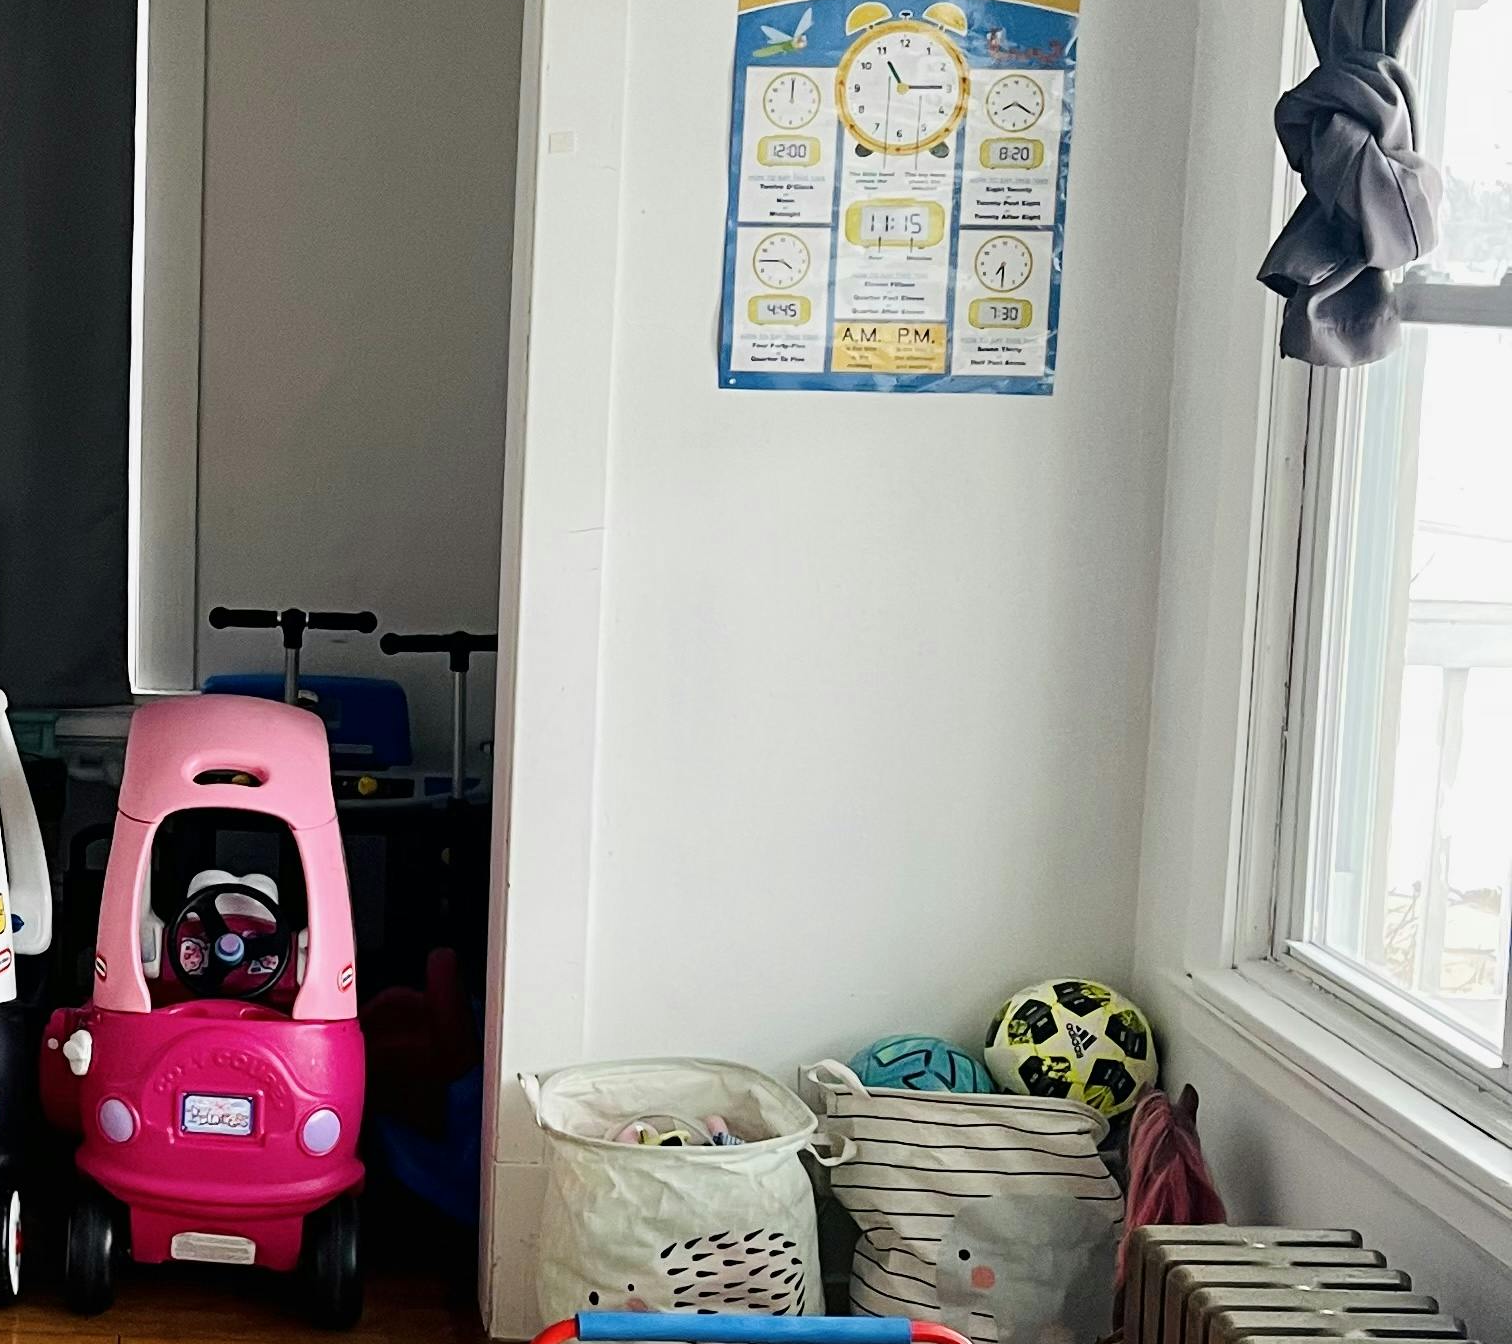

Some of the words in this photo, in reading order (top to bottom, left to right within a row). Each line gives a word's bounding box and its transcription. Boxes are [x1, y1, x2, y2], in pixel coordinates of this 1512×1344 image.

[900, 39, 910, 48] 12
[877, 47, 887, 55] 11
[926, 47, 931, 55] 1
[861, 62, 872, 70] 10
[854, 84, 861, 92] 9
[896, 129, 902, 137] 6
[773, 144, 806, 158] 12:00
[999, 147, 1029, 161] 8:20
[871, 213, 921, 234] 11:15
[767, 303, 797, 317] 4:45
[990, 307, 1018, 321] 7:30
[842, 327, 882, 343] A.M.
[898, 328, 935, 344] P.M.
[1066, 1023, 1084, 1058] adidas
